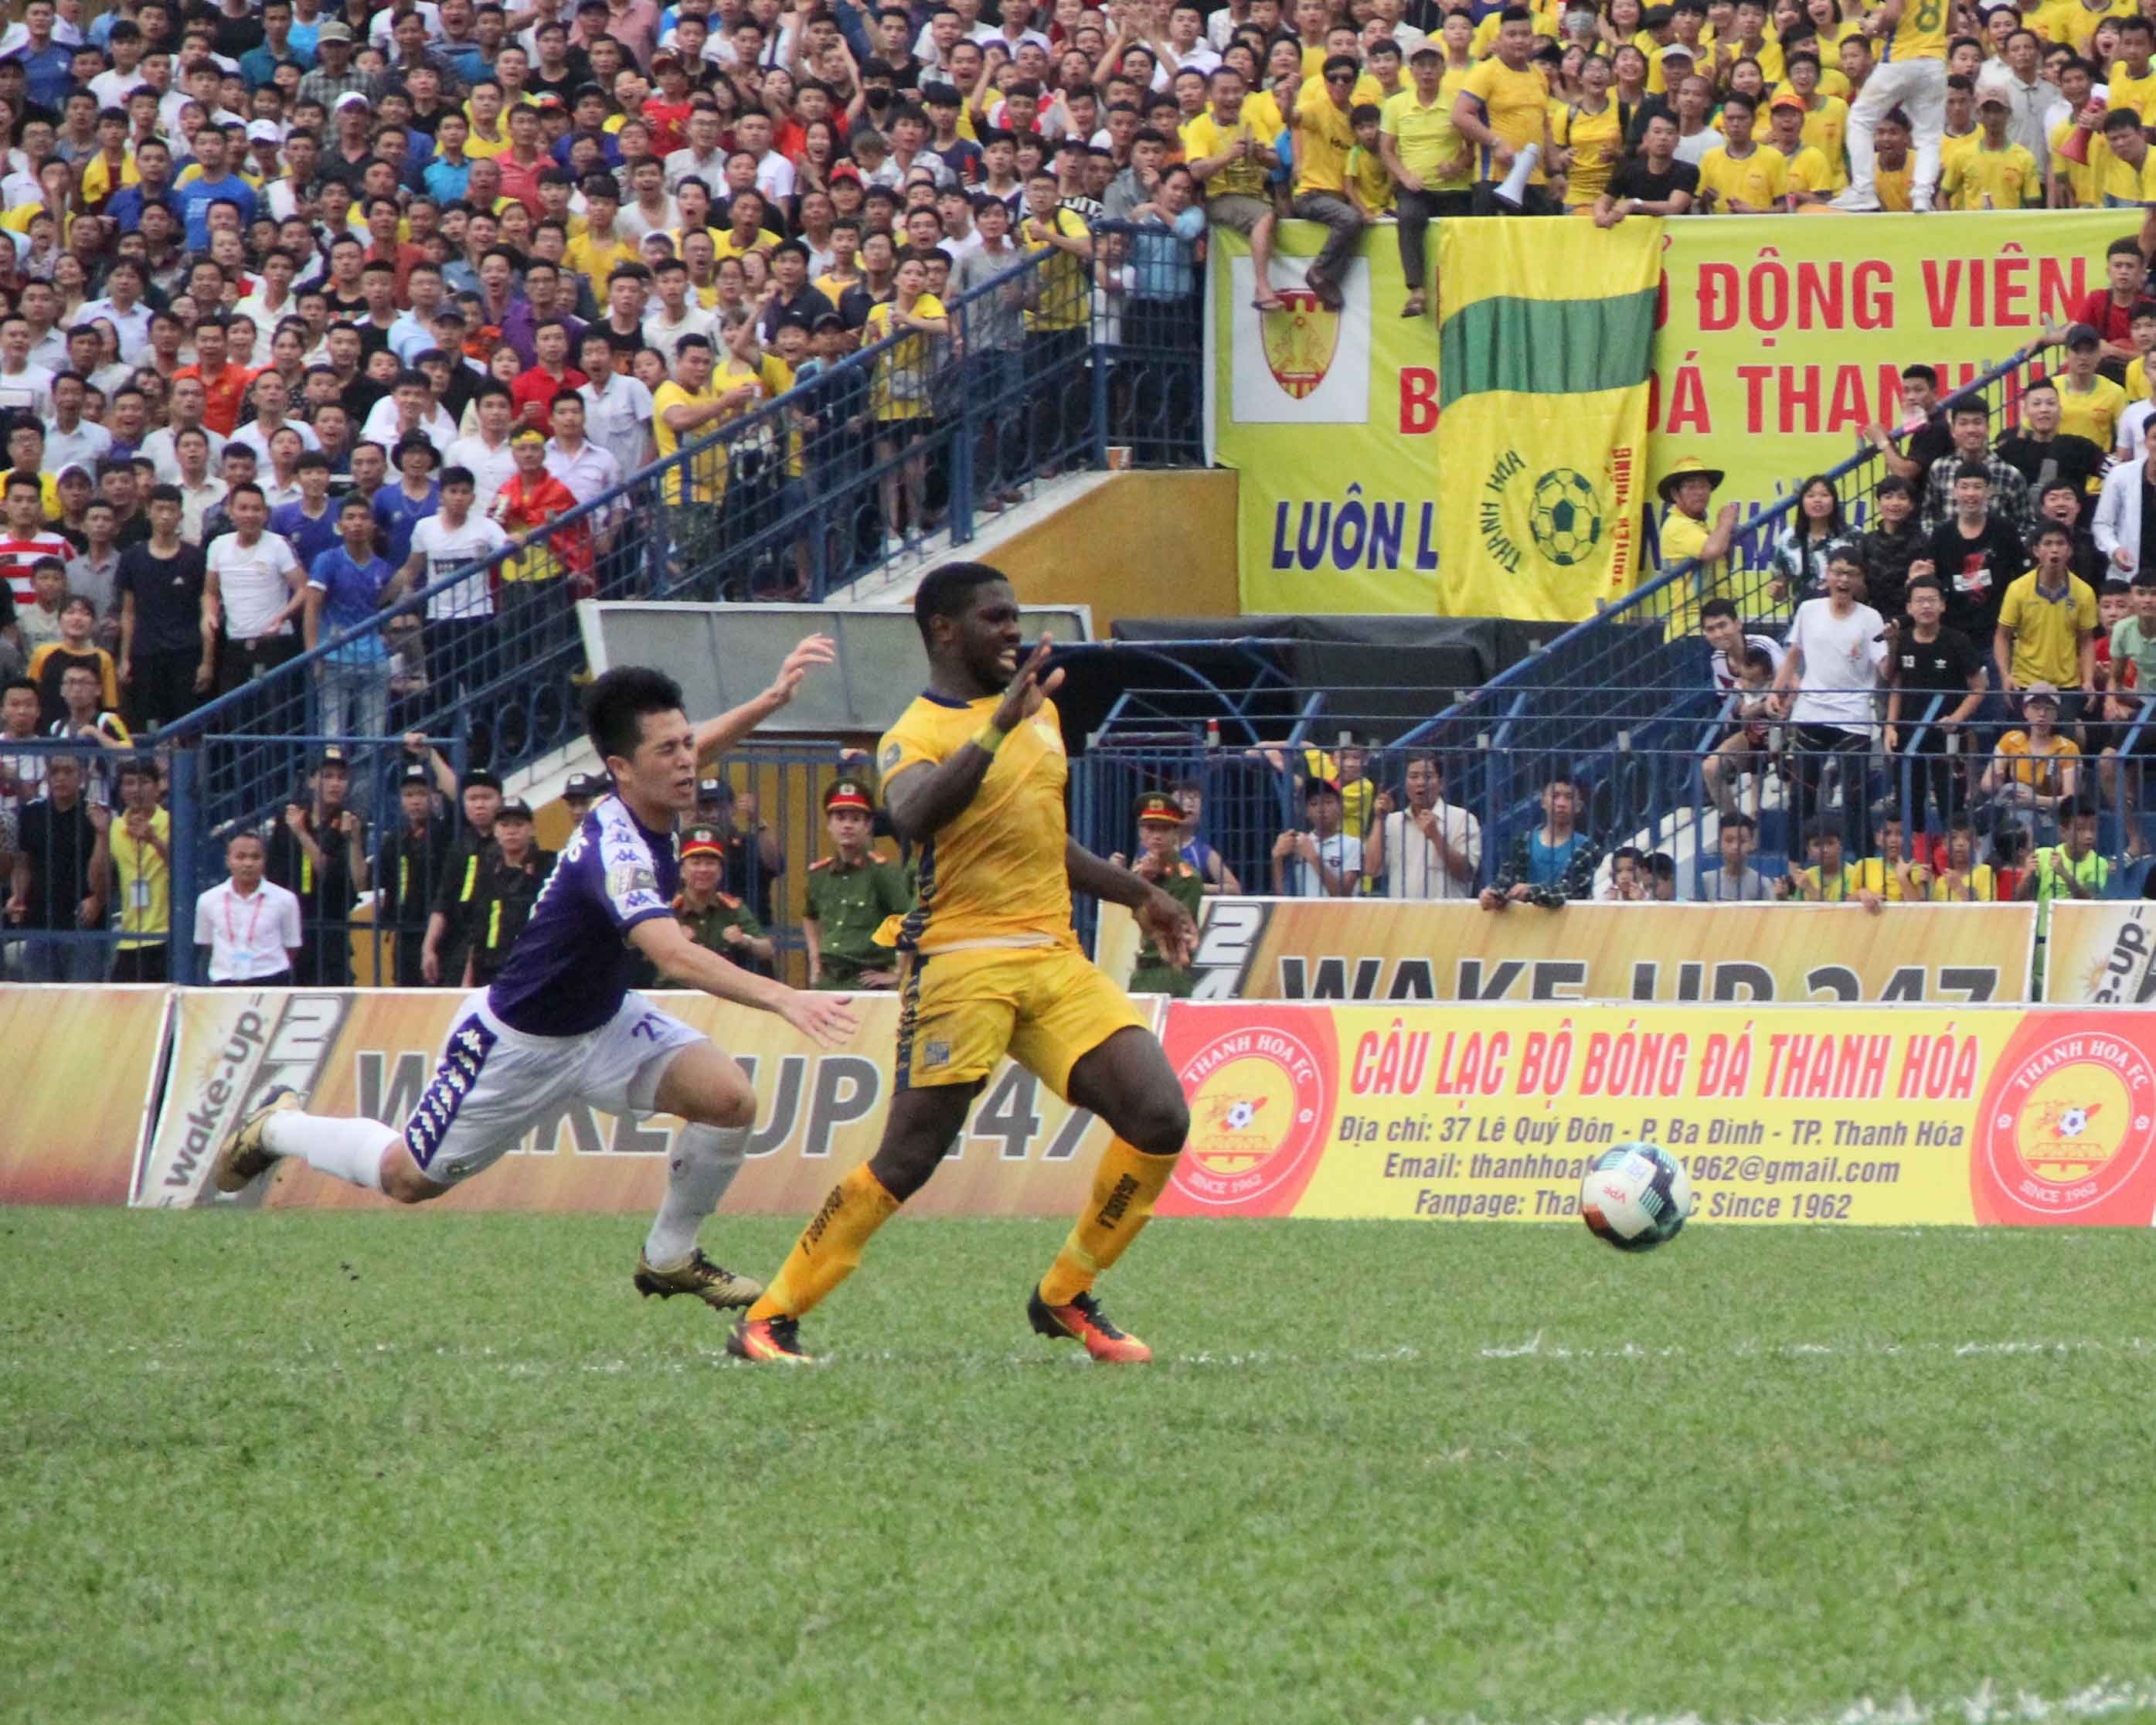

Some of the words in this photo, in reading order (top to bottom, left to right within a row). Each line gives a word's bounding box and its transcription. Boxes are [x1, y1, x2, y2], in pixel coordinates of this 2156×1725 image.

[1696, 247, 1893, 346] ĐỘNG
[1921, 242, 2086, 328] VIÊN
[1272, 481, 1406, 570] LUÔN
[1480, 502, 1522, 573] THANH
[1185, 1035, 1250, 1083] THANH
[1257, 1034, 1295, 1063] HOA
[1292, 1058, 1314, 1084] FC
[1351, 1017, 1432, 1095] CÂU
[1434, 1031, 1511, 1111] LẠC
[1516, 1018, 1573, 1111] BỘ
[1579, 1019, 1691, 1097] BÓNG
[1695, 1019, 1754, 1097] ĐÁ
[1763, 1033, 1893, 1099] THANH
[1897, 1021, 1979, 1101] HÓA
[2015, 1040, 2083, 1090] THANH
[2089, 1040, 2129, 1068] HOA
[2126, 1063, 2149, 1090] FC
[164, 1011, 265, 1186] wake-up
[733, 1055, 881, 1157] UP
[1338, 1116, 1379, 1148] Địa
[1440, 1117, 1472, 1142] 37
[1477, 1116, 1507, 1142] Lê
[1513, 1117, 1560, 1146] Quý
[1566, 1117, 1614, 1144] Đôn
[1640, 1118, 1658, 1144] P.
[1667, 1119, 1700, 1145] Ba
[1707, 1119, 1765, 1145] Đình
[1792, 1120, 1823, 1145] TP.
[1834, 1121, 1909, 1146] Thanh
[1914, 1121, 1965, 1147] Hóa
[1188, 1172, 1227, 1194] SINCE
[1383, 1152, 1463, 1179] Email:
[1414, 1189, 1525, 1218] Fanpage:
[1709, 1193, 1781, 1218] Since
[1792, 1194, 1853, 1220] 1962
[2018, 1179, 2061, 1203] SINCE
